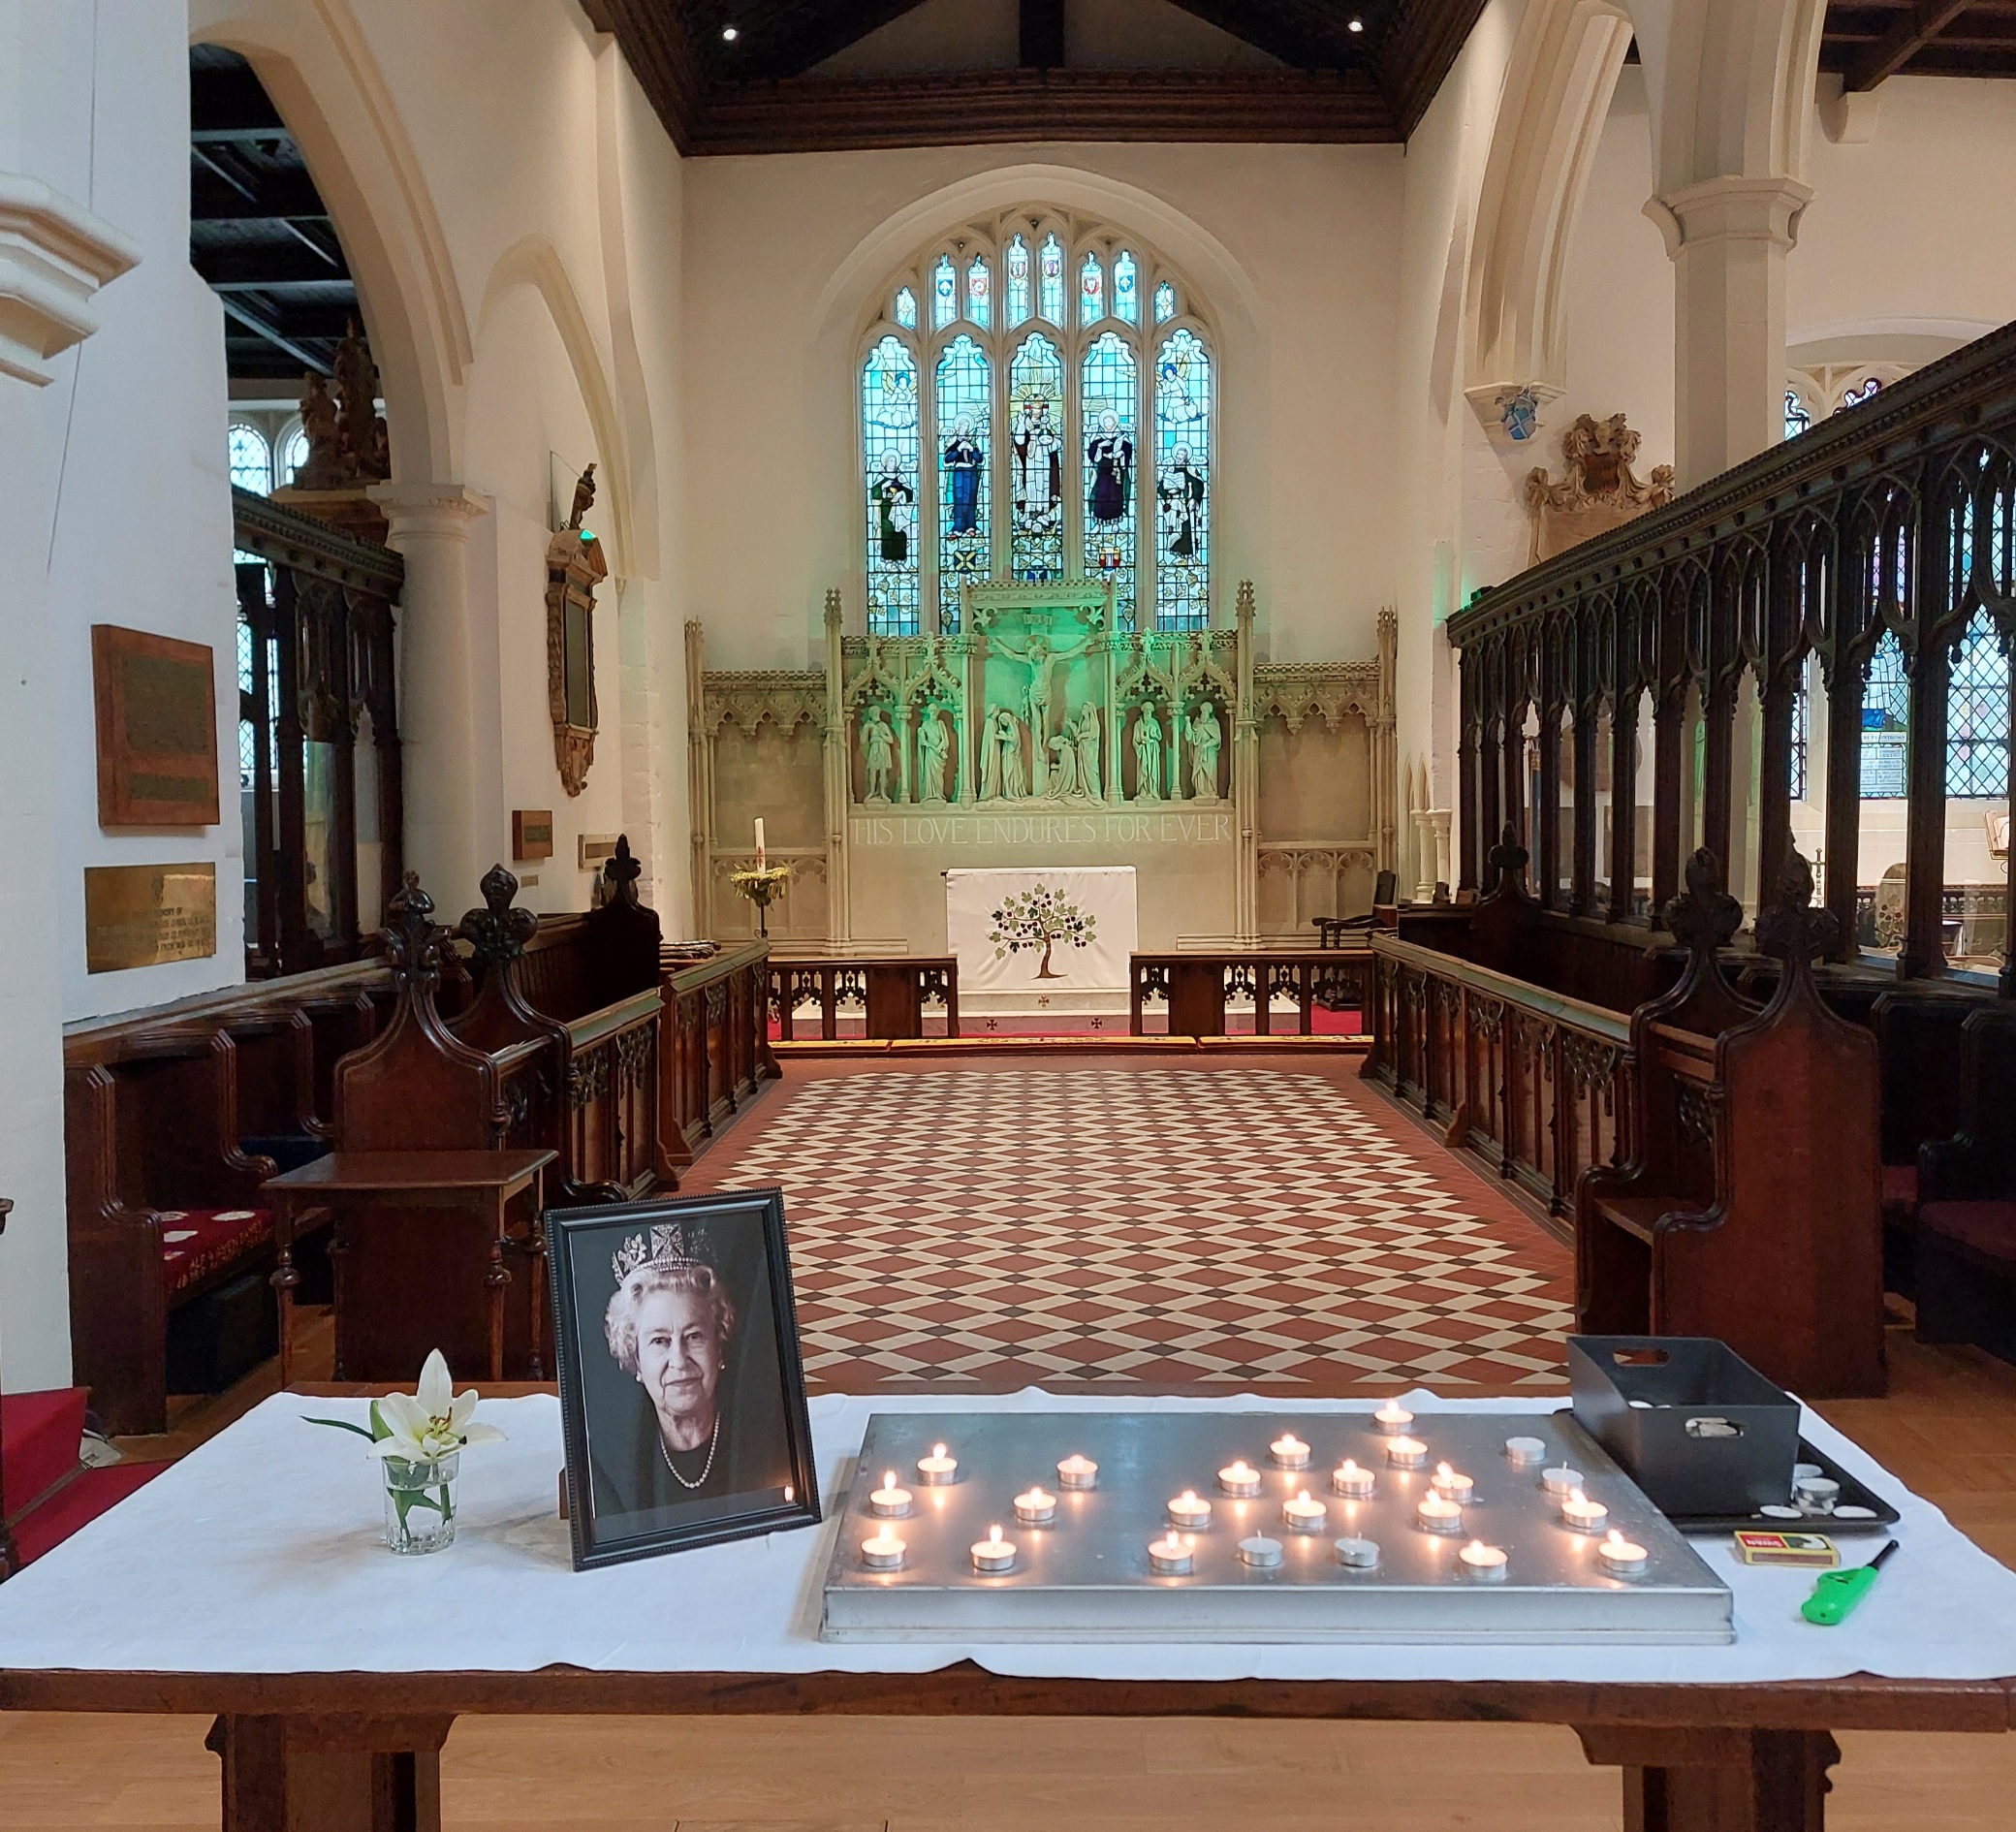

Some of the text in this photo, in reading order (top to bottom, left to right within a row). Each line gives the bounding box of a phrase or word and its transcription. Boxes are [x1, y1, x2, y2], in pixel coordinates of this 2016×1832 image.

[854, 813, 1232, 845] HIS LOVE ENDURES FOR EVER
